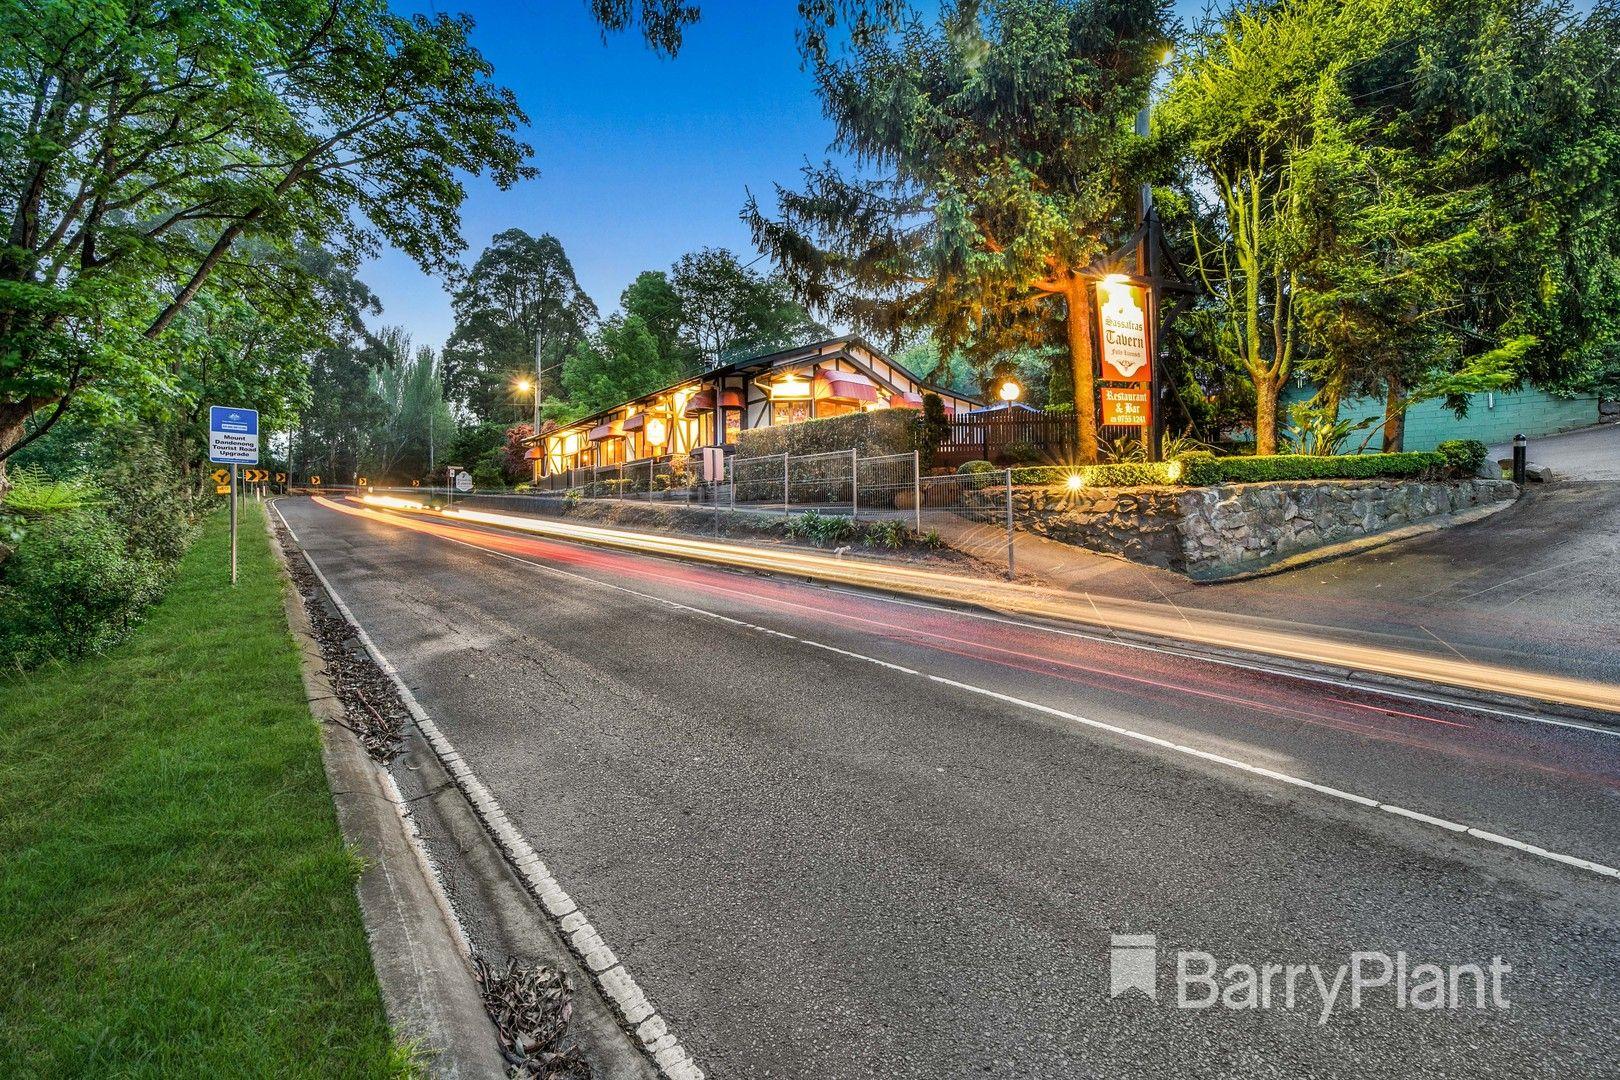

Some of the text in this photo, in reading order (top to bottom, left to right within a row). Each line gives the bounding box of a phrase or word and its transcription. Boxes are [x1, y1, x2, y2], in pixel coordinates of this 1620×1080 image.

[1106, 330, 1143, 348] Tavern
[1106, 390, 1147, 402] Restaurant
[1115, 402, 1140, 414] & Bar
